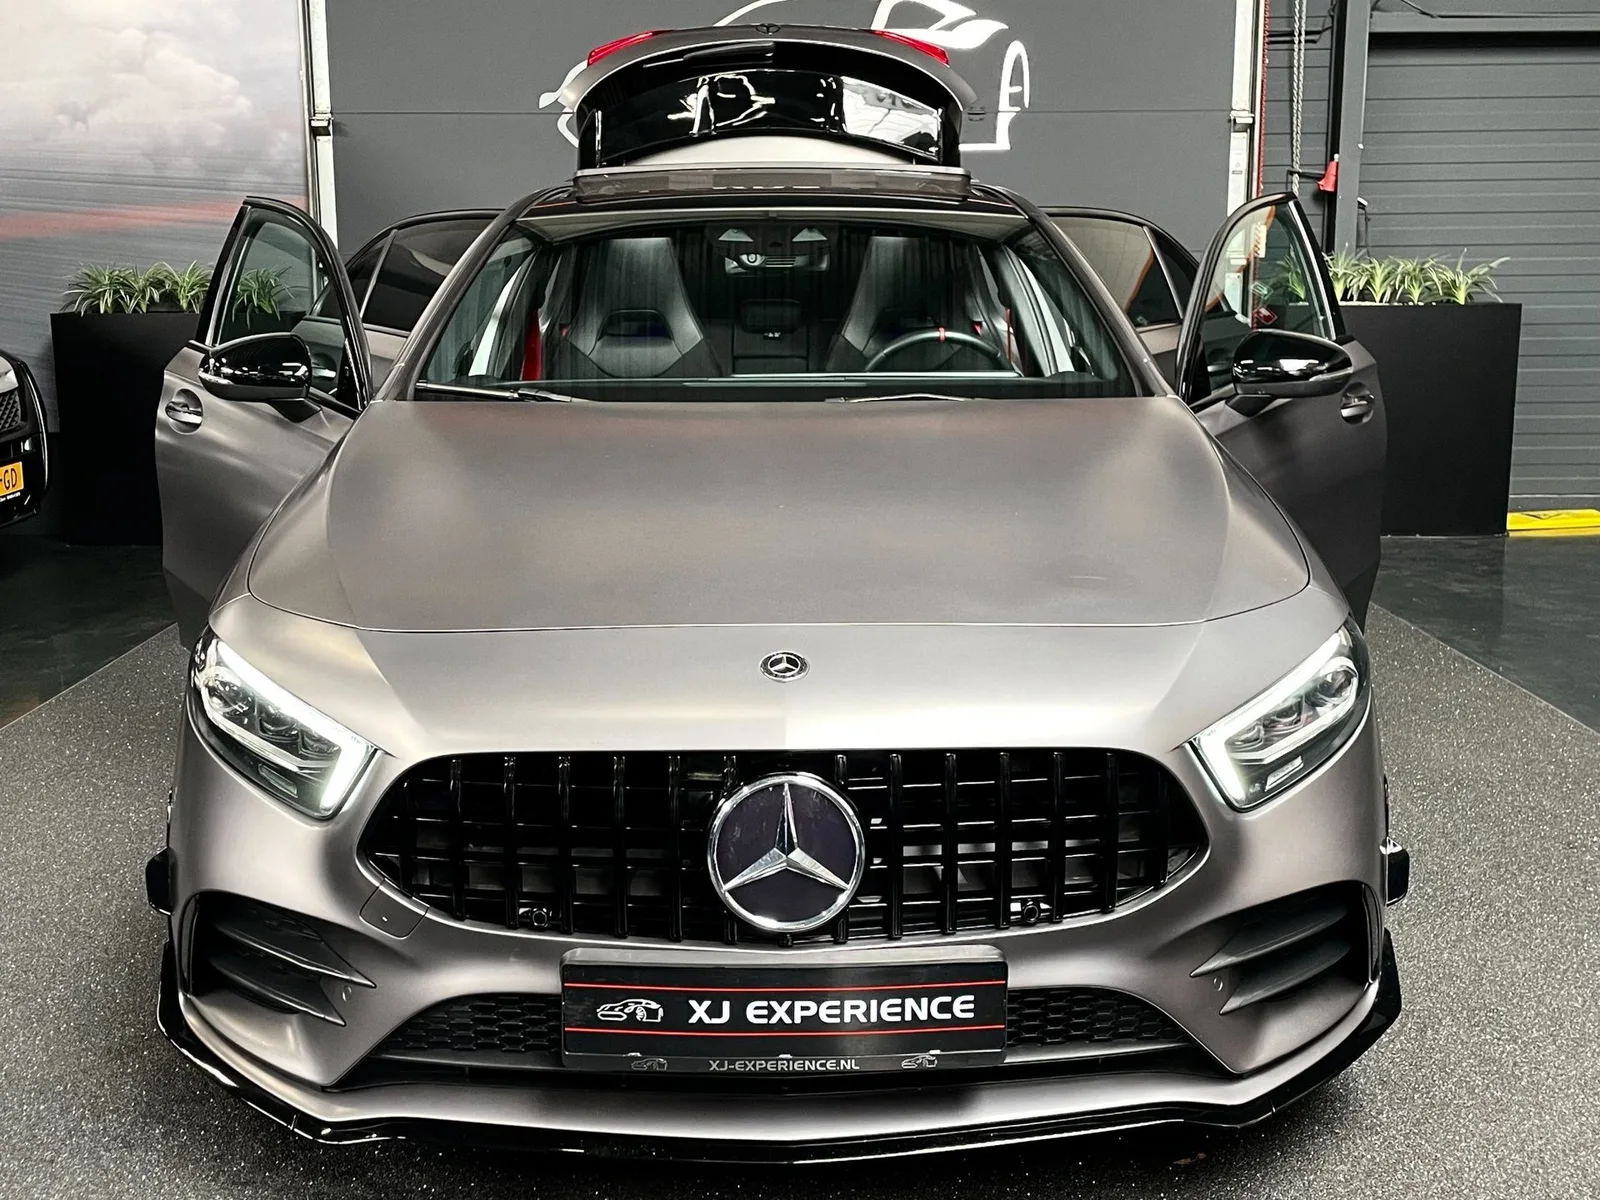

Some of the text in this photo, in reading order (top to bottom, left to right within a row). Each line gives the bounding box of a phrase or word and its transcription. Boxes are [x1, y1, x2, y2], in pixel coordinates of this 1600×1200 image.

[688, 995, 975, 1024] XJ EXPERIENCE
[709, 1059, 860, 1071] XJ-EXPERIENCE.NL
